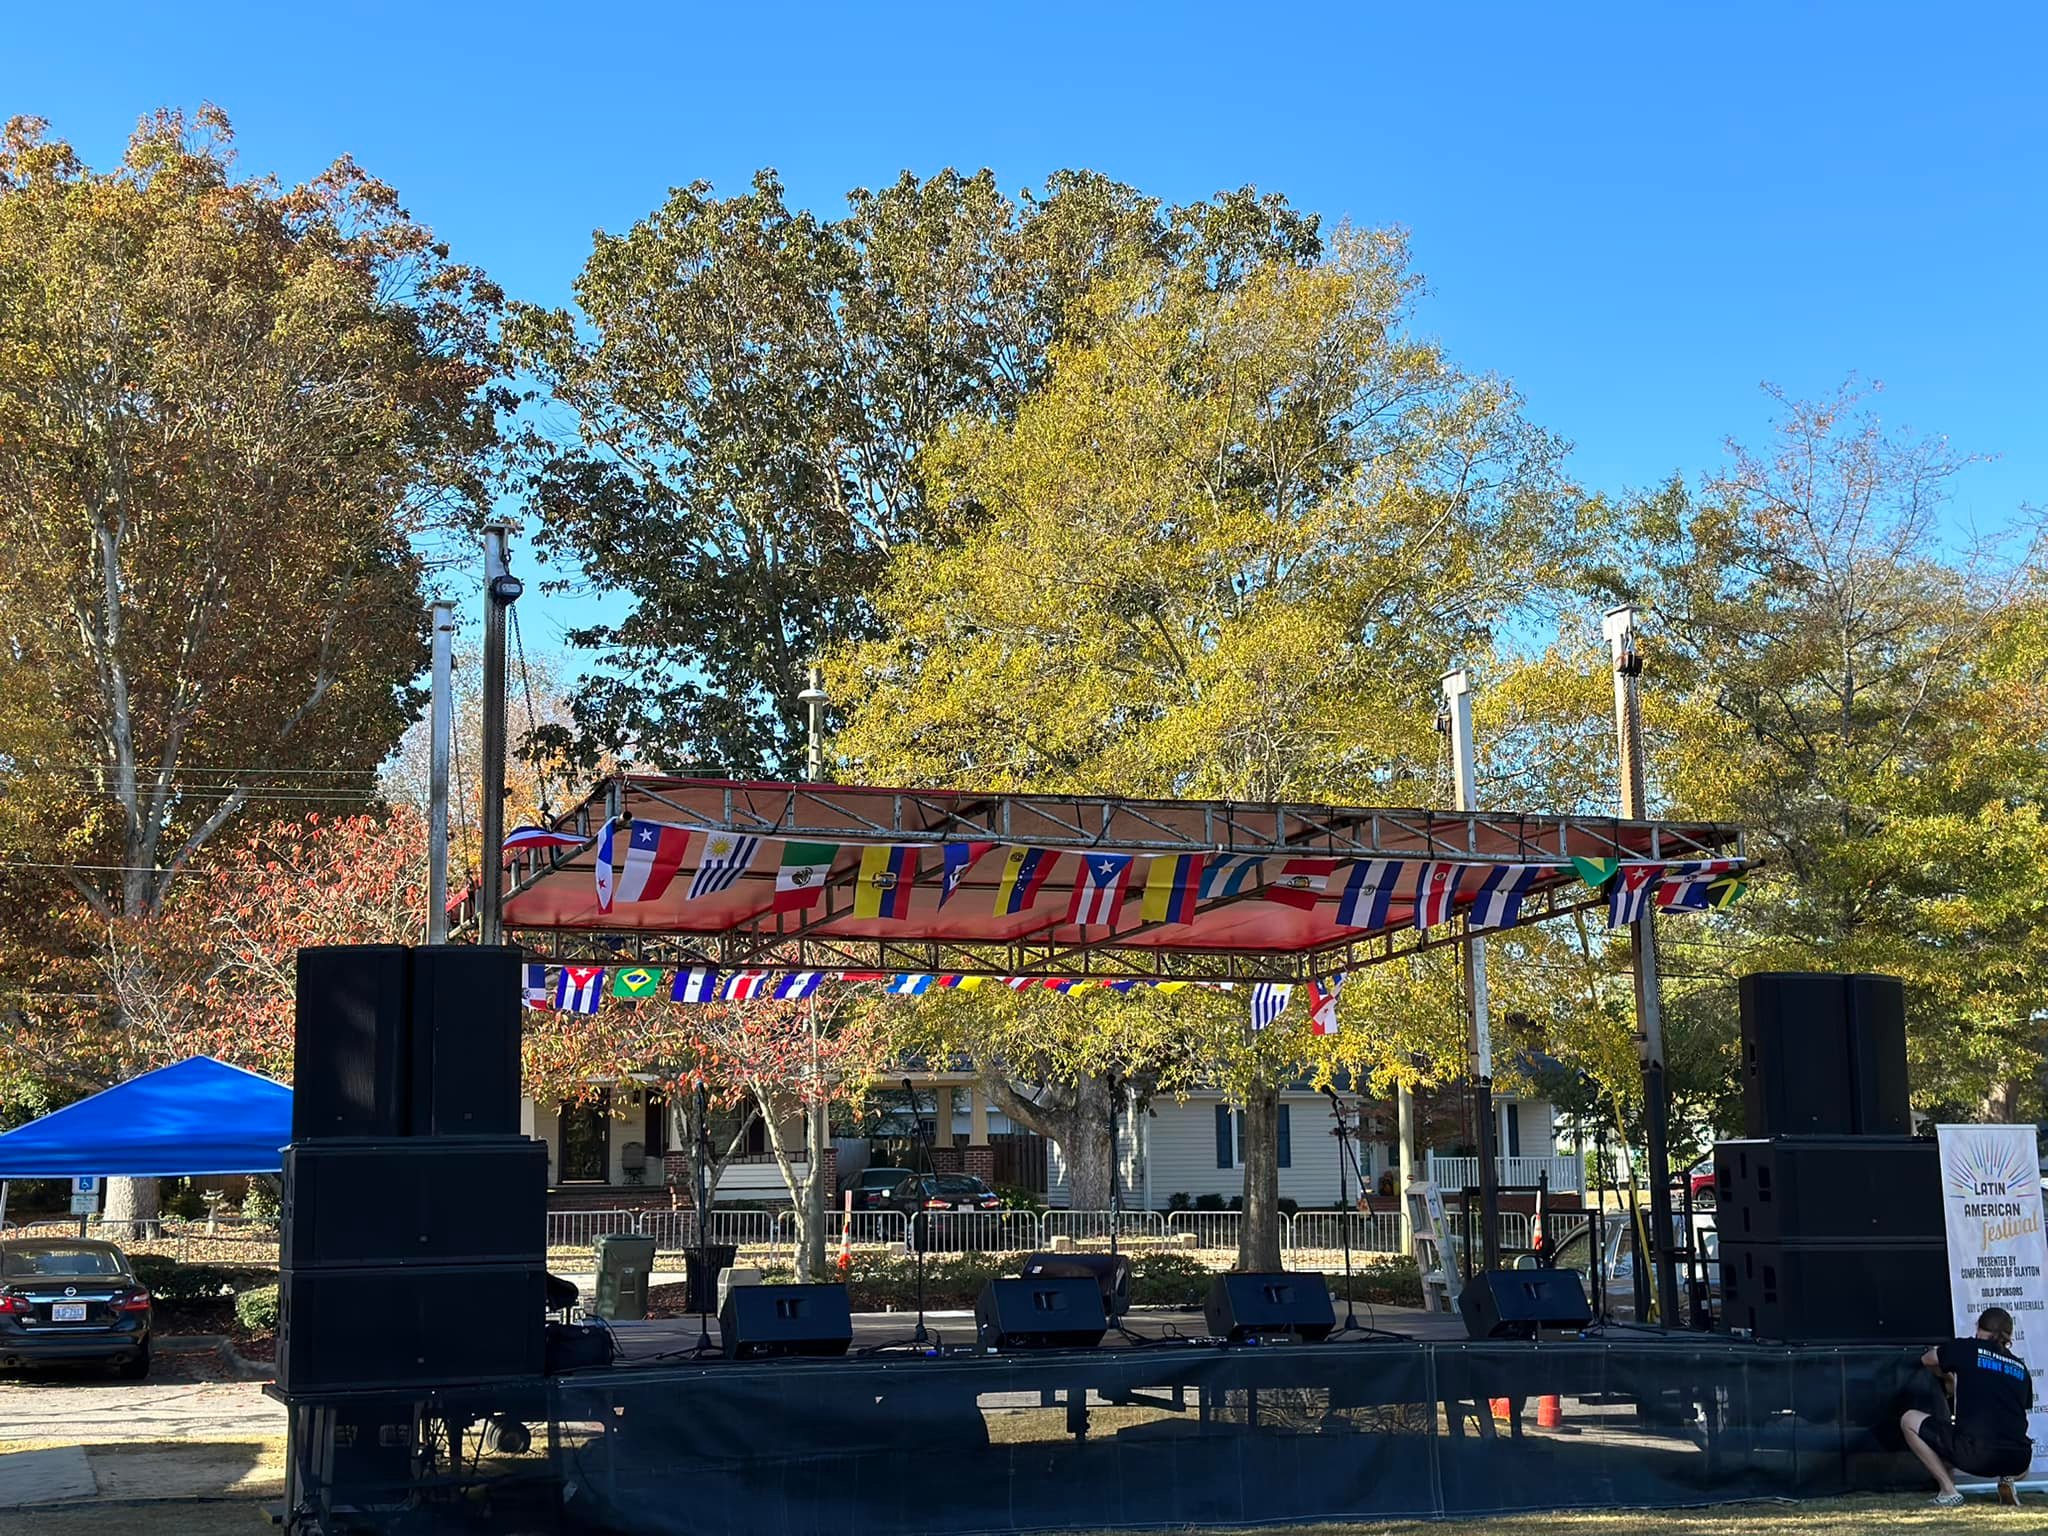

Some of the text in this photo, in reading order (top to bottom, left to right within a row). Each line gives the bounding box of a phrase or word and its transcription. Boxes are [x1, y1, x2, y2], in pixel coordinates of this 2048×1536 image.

[1974, 1182, 2006, 1196] LATIN
[1964, 1203, 2021, 1217] AMERICAN
[1982, 1210, 2039, 1251] festival
[1977, 1256, 2016, 1267] PRESENTED BY
[1961, 1265, 2041, 1279] COMPARE FOODS OF CLAYTON
[1981, 1287, 2024, 1298] GOLD SPONSORS
[2014, 1300, 2045, 1311] MATERIALS
